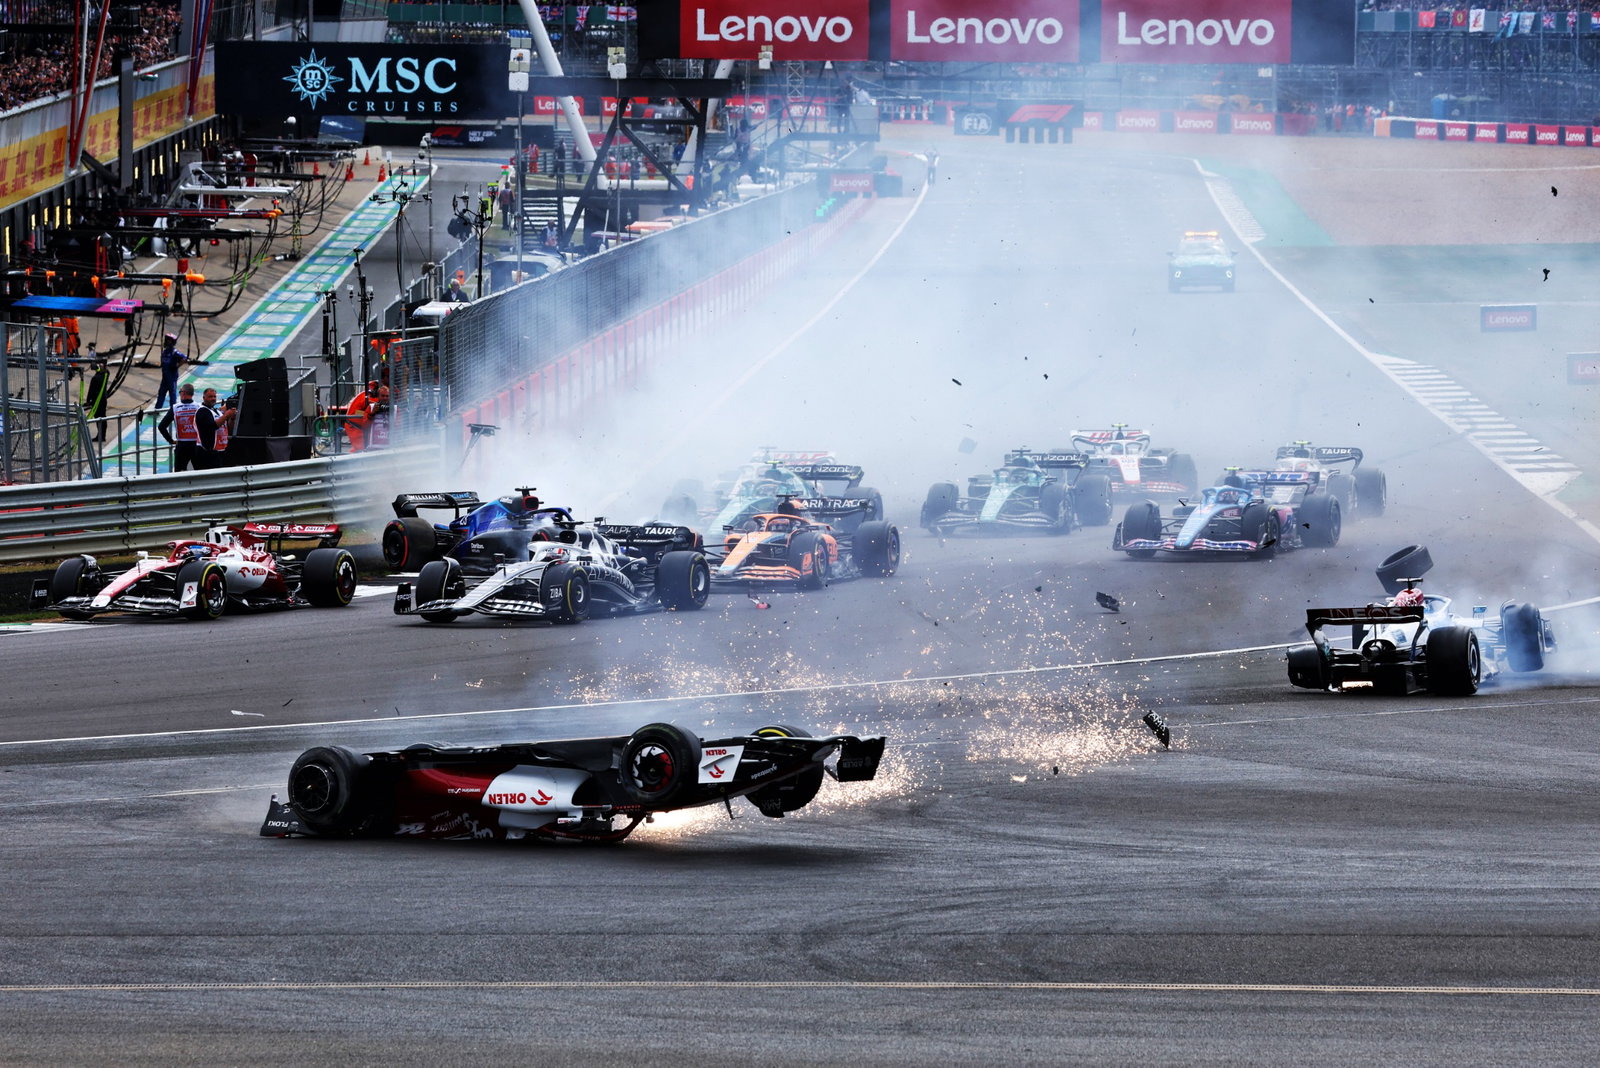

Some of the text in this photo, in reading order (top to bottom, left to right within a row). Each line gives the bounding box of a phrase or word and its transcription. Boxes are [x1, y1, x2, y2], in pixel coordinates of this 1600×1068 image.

[697, 8, 853, 43] Lenovo
[907, 10, 1064, 45] Lenovo
[1118, 12, 1276, 46] Lenovo
[347, 57, 457, 94] MSC
[347, 101, 458, 112] CRUISES
[1120, 116, 1156, 127] Lenovo
[1177, 117, 1214, 128] Lenovo
[1234, 119, 1272, 130] Lenovo
[1416, 125, 1438, 135] Lenovo
[1446, 126, 1467, 136] Lenovo
[1476, 128, 1496, 138] Lenovo
[1506, 129, 1527, 139] Lenovo
[1537, 130, 1558, 140] Lenovo
[1566, 131, 1585, 141] Lenovo
[834, 177, 870, 187] Lenovo
[1489, 315, 1528, 324] Lenovo
[254, 543, 265, 552] 77
[252, 568, 266, 576] ORLEN
[550, 587, 562, 598] ZIBA
[1328, 608, 1402, 618] INEOS
[706, 748, 727, 757] ORLEN
[489, 792, 526, 805] ORLEN
[268, 820, 289, 828] FLOKI
